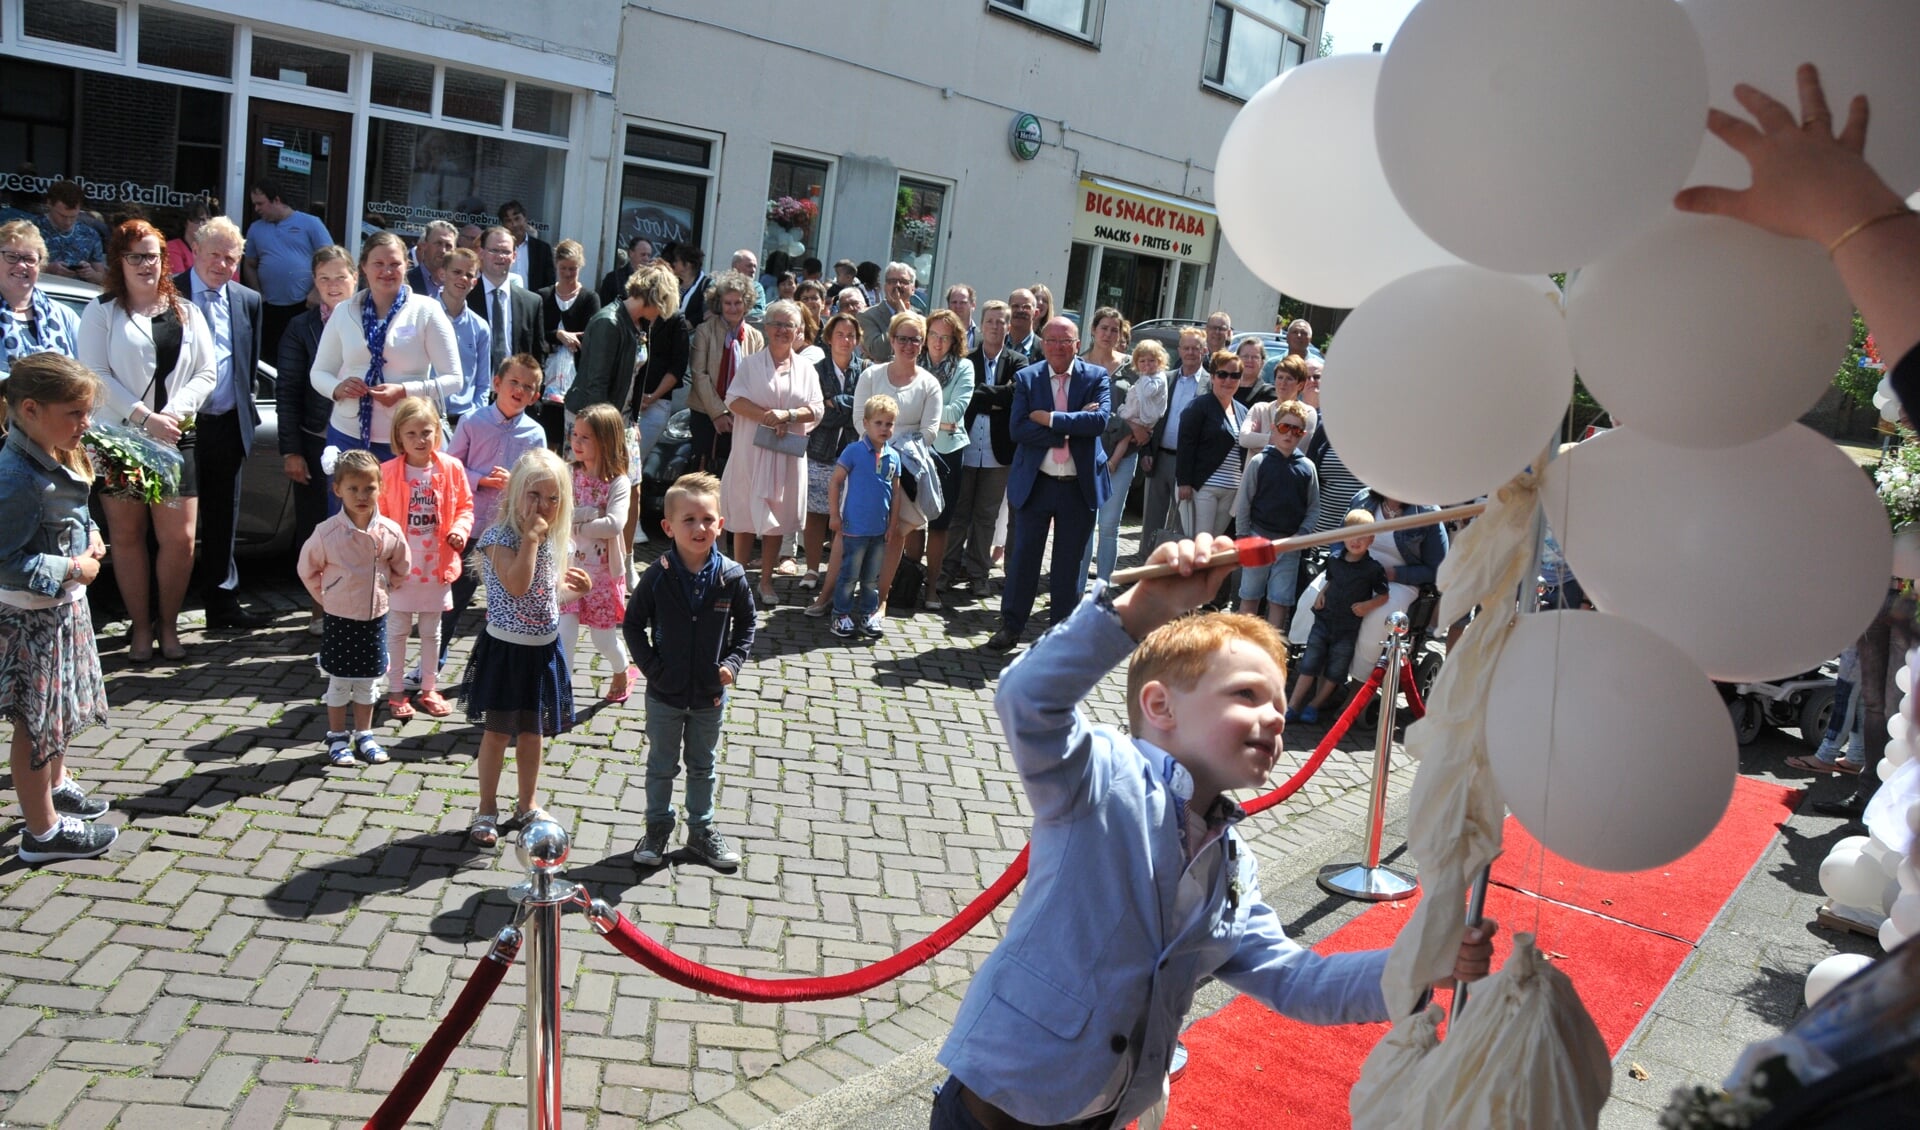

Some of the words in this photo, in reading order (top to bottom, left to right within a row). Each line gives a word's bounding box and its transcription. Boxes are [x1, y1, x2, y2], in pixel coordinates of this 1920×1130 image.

[368, 201, 413, 217] verkoop
[415, 207, 453, 220] nieuwe
[455, 212, 467, 221] en
[1085, 191, 1113, 216] BIG
[1115, 198, 1165, 229] SNACK
[1168, 210, 1205, 237] TABA
[1094, 225, 1131, 243] SNACKS
[1141, 235, 1171, 251] FRITES
[1181, 243, 1192, 256] IJS
[408, 513, 440, 526] TODA
